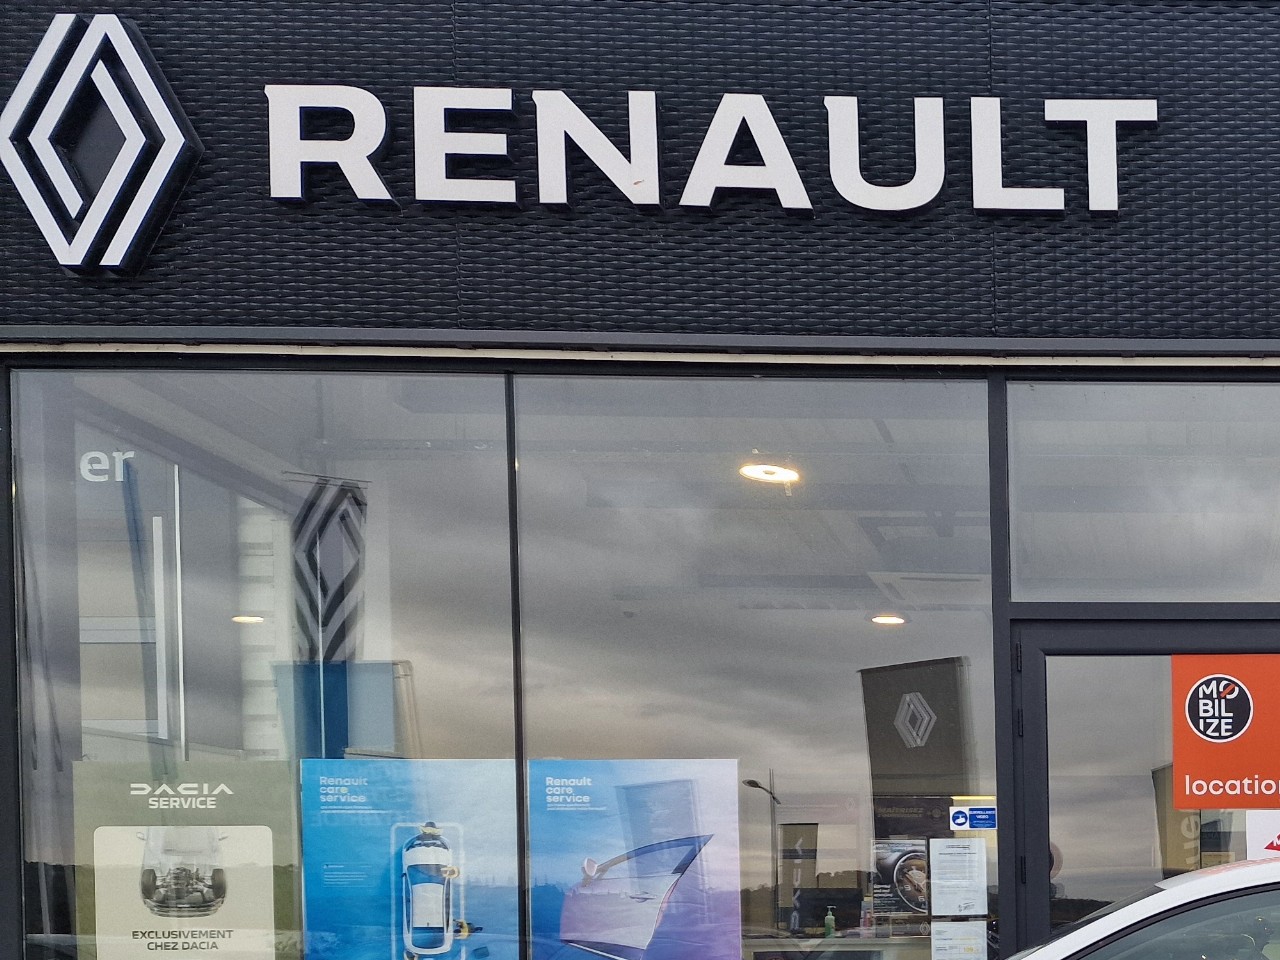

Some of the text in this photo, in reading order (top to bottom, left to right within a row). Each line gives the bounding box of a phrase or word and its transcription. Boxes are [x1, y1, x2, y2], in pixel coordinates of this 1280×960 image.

[264, 84, 1159, 213] RENAULT
[320, 776, 368, 786] Renault
[546, 776, 592, 786] Renault
[130, 783, 234, 795] DACIA
[320, 786, 349, 794] care
[546, 786, 573, 794] care
[320, 793, 366, 802] service
[546, 794, 590, 803] service
[149, 797, 217, 809] SERVICE
[132, 930, 234, 941] EXCLUSIVEMENT
[147, 941, 219, 951] CHEZ DACIA
